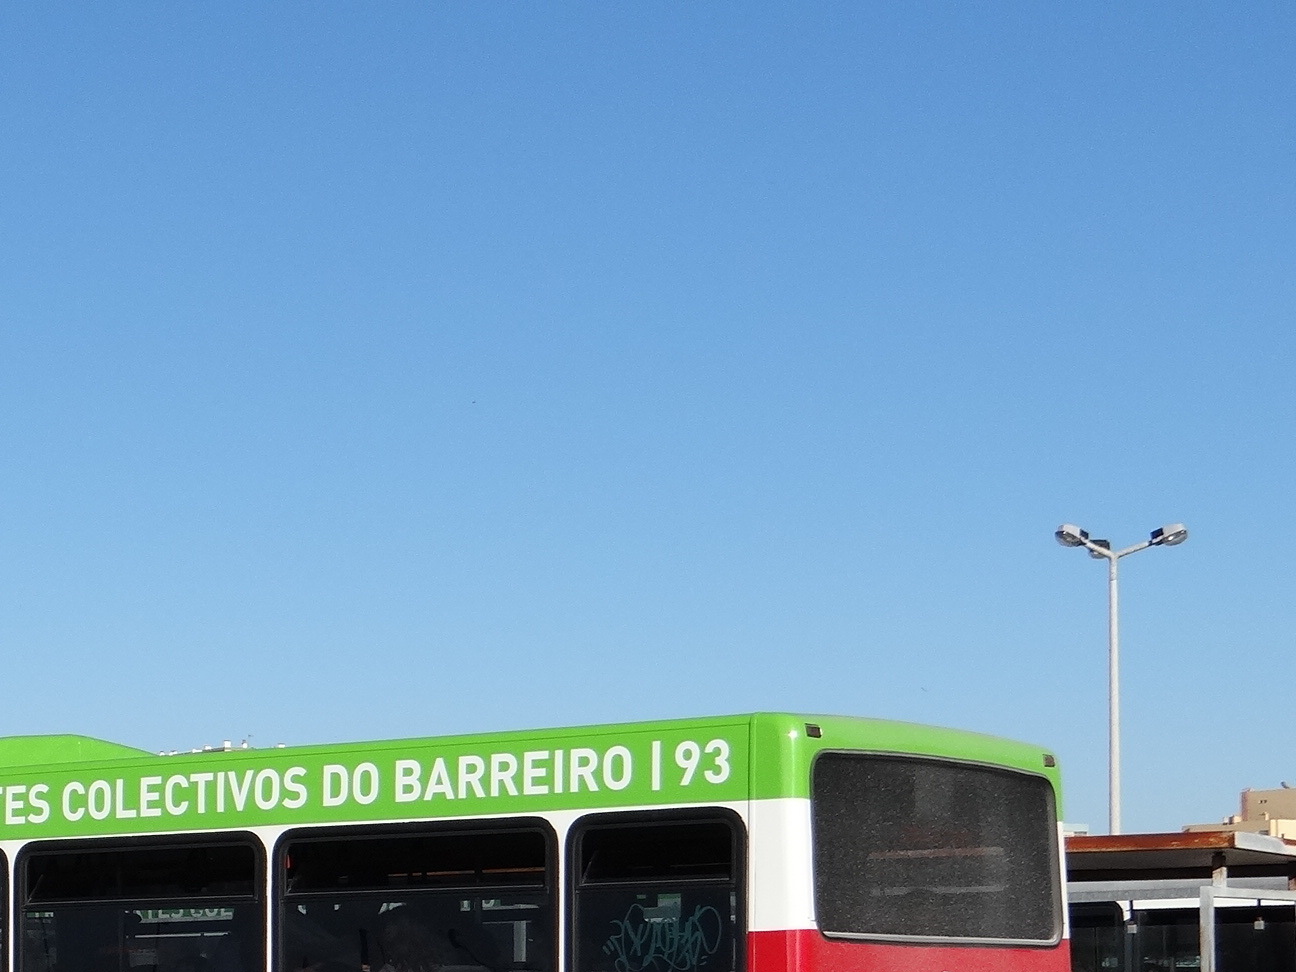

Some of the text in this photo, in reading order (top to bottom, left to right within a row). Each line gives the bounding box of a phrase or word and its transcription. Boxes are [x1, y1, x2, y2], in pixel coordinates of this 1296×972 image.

[62, 766, 307, 821] COLECTIVOS
[322, 762, 379, 807] DO
[394, 745, 633, 803] BARREIRO
[674, 738, 731, 785] 93
